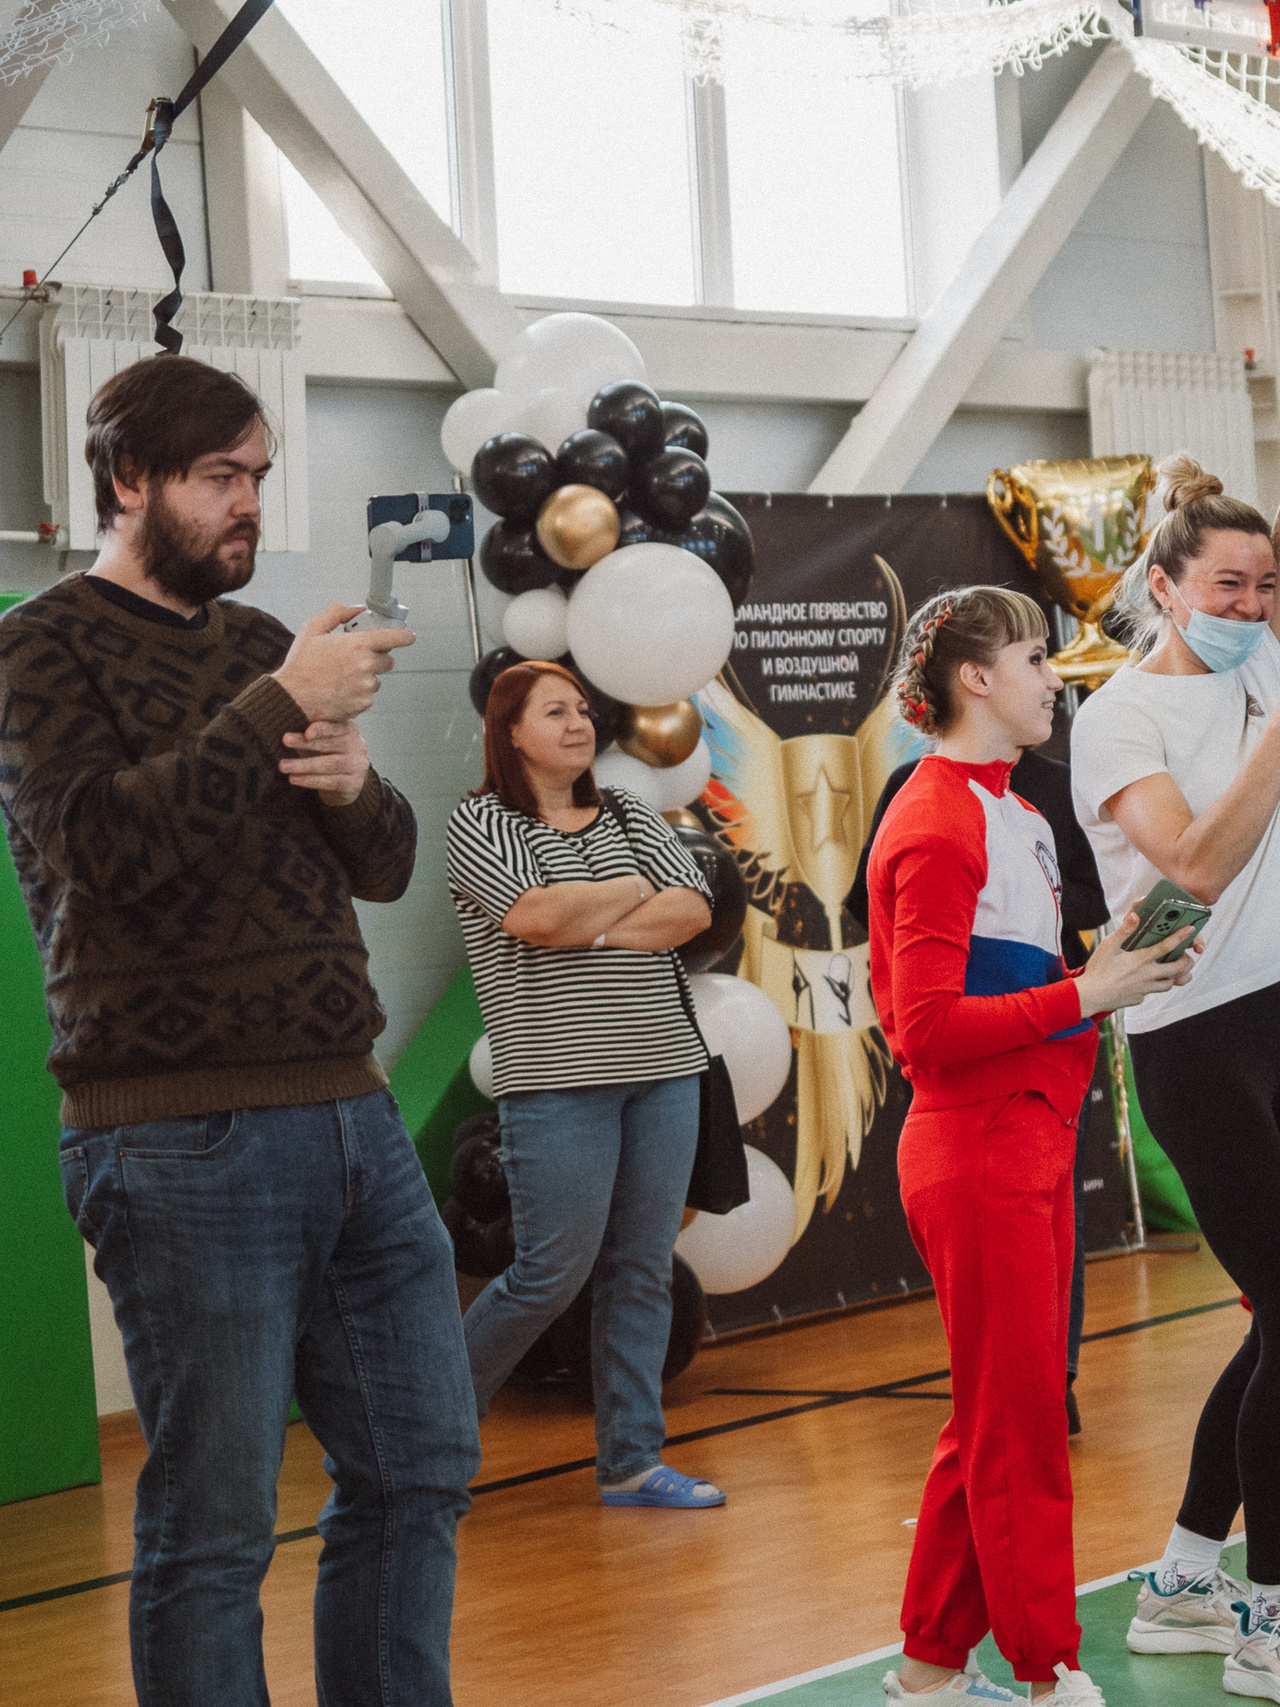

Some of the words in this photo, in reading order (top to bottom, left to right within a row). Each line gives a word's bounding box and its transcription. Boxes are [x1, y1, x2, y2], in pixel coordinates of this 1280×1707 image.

[1086, 502, 1105, 552] 1
[809, 602, 887, 619] ПЕРВЕНСТВО
[751, 629, 835, 648] ПИЛОННОМУ
[838, 627, 886, 646] СПОРТУ
[762, 658, 773, 676] И
[775, 653, 859, 676] ВОЗДУШНОЙ
[770, 682, 857, 701] ГИМНАСТИКЕ
